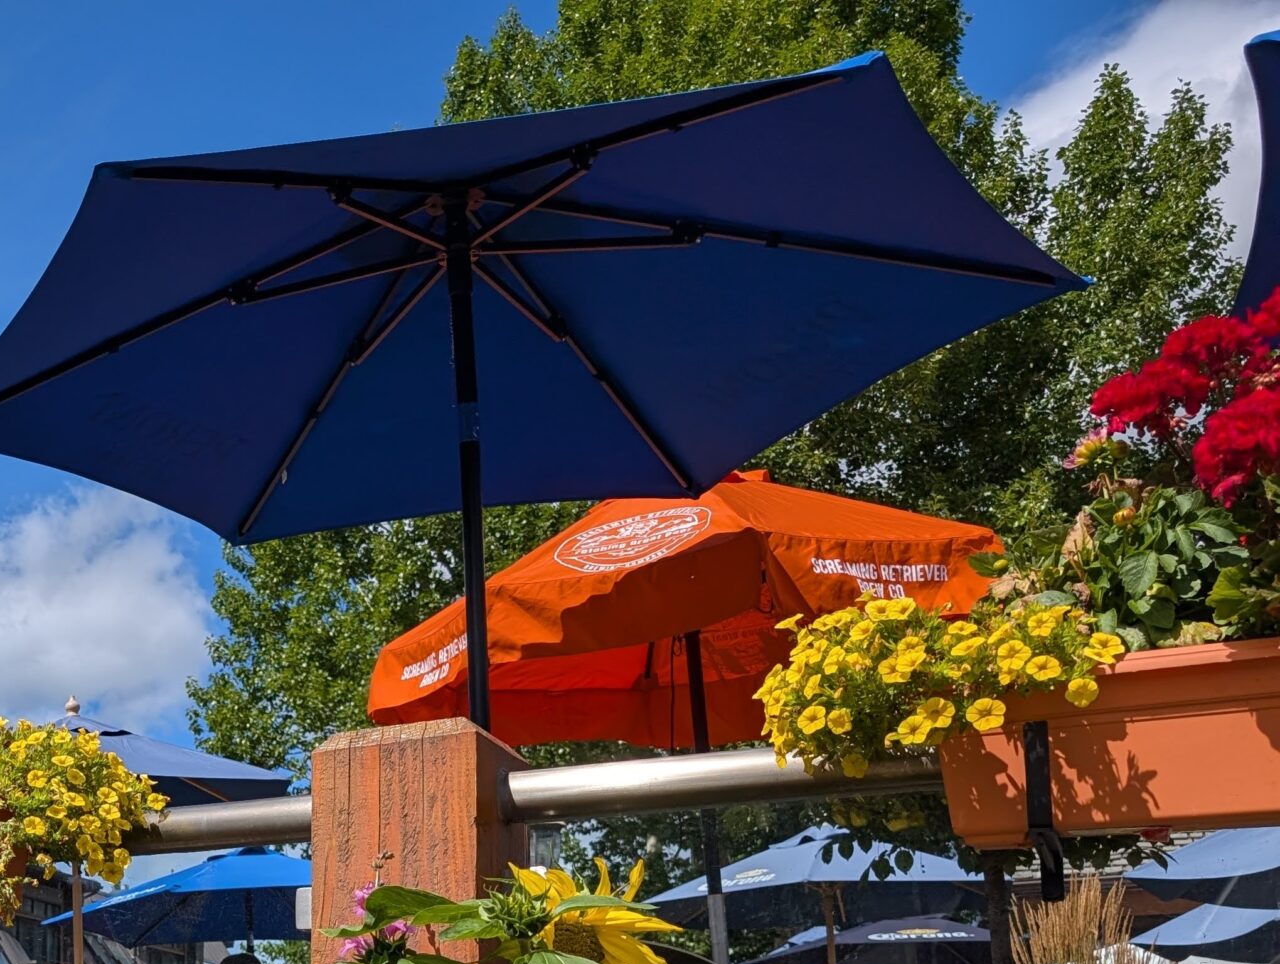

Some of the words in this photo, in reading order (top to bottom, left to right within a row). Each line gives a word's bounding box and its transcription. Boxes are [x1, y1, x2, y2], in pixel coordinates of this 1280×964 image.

[811, 557, 878, 580] SCREAMING
[880, 564, 948, 582] RETRIEVER
[857, 579, 884, 599] BREW
[889, 583, 906, 599] CO
[401, 652, 437, 680] SCREAMING
[439, 632, 467, 664] RETRIEVE
